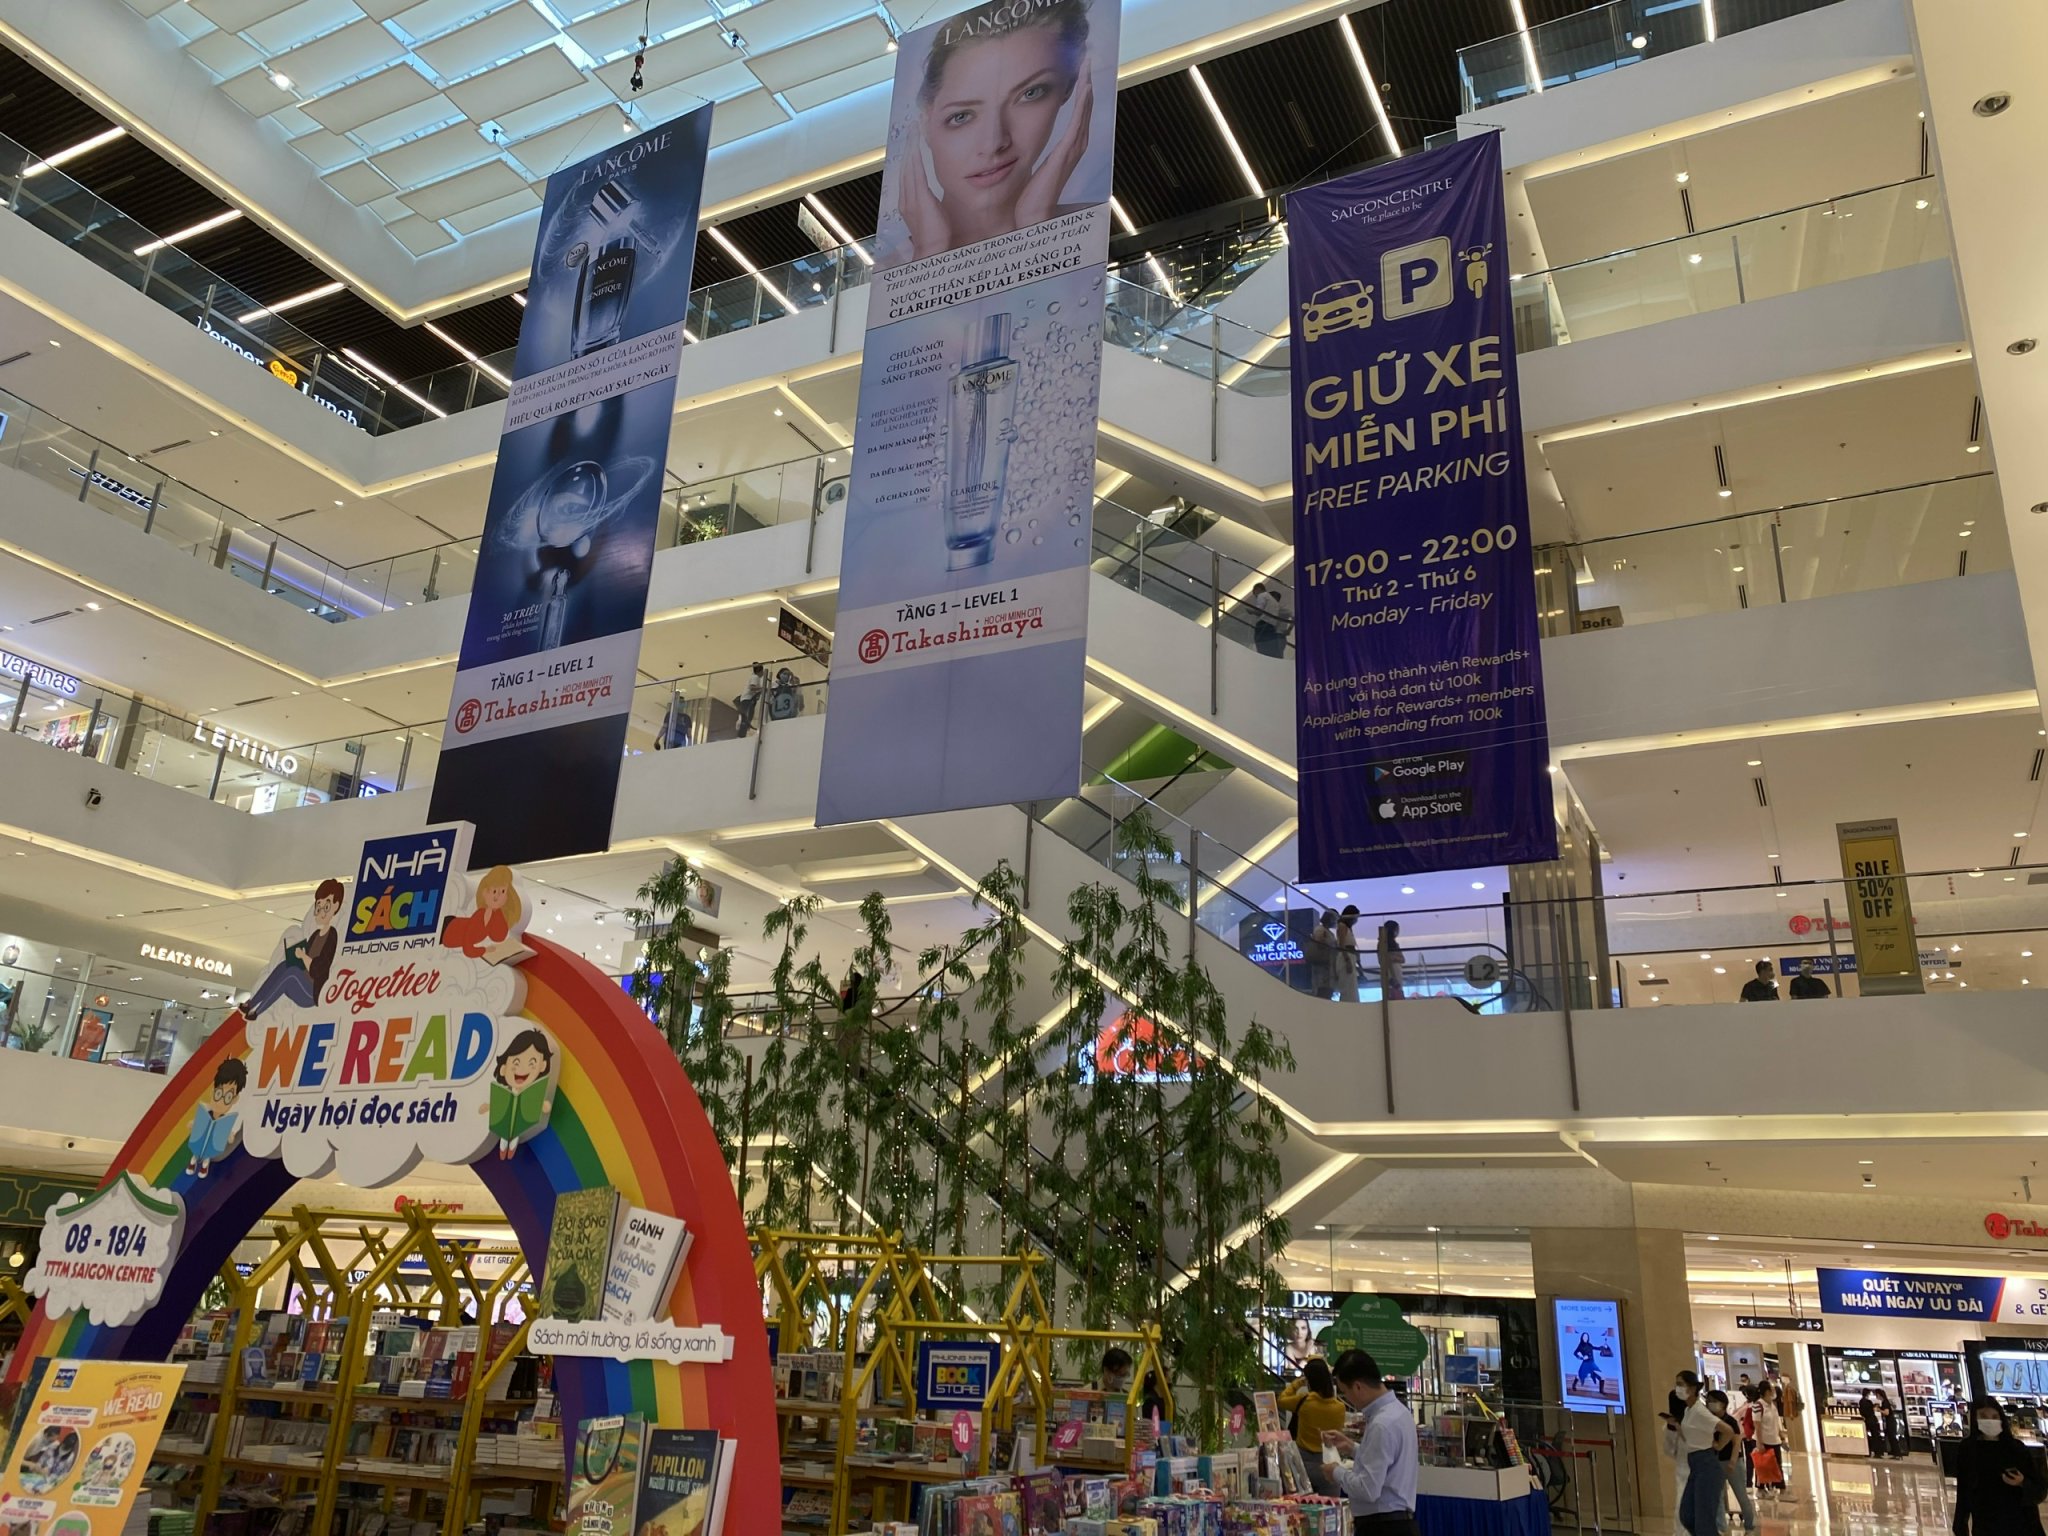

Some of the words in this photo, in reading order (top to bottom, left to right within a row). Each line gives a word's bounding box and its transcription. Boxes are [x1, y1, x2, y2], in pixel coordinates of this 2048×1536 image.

[581, 131, 673, 185] LANCÔME
[609, 163, 638, 180] PARIS
[1362, 214, 1378, 226] The
[1378, 207, 1400, 222] place
[1402, 205, 1410, 214] to
[1412, 201, 1422, 211] be
[886, 279, 906, 293] THU
[1029, 234, 1050, 250] SAU
[1023, 248, 1059, 269] SÁNG
[1062, 242, 1082, 257] DA
[888, 287, 973, 320] CLARIFIQUE
[975, 275, 1015, 295] DUAL
[1017, 255, 1082, 282] ESSENCE
[1399, 257, 1439, 306] P
[513, 380, 538, 396] CHAI
[537, 371, 567, 388] SERUM
[628, 330, 677, 356] LANCÔME
[886, 361, 908, 373] CHO
[930, 352, 943, 362] DA
[908, 363, 943, 379] TRONG
[588, 382, 617, 400] NGAY
[615, 376, 637, 391] SAU
[1304, 350, 1411, 420] GIỮ
[1422, 335, 1503, 395] XE
[1305, 412, 1416, 476] MIỄN
[1431, 387, 1507, 446] PHÍ
[1304, 479, 1372, 516] FREE
[1377, 451, 1511, 500] PARKING
[1304, 549, 1389, 587] 17:00
[1422, 524, 1518, 565] 22:00
[1343, 583, 1383, 603] Thứ
[1387, 580, 1399, 597] 2
[1418, 569, 1460, 590] Thứ
[1464, 564, 1477, 581] 6
[940, 601, 948, 614] 1
[964, 591, 1006, 610] LEVEL
[1010, 588, 1018, 601] 1
[1331, 606, 1410, 632] Monday
[1429, 592, 1494, 615] Friday
[984, 616, 994, 625] HO
[994, 613, 1007, 624] CHI
[1007, 610, 1027, 622] MINH
[1027, 606, 1044, 619] CITY
[892, 615, 1043, 653] Takashimaya
[527, 670, 534, 682] 1
[548, 659, 583, 679] LEVEL
[586, 656, 595, 669] 1
[1325, 676, 1357, 693] dụng
[1360, 671, 1386, 686] cho
[1388, 665, 1427, 682] thành
[1430, 661, 1459, 674] viên
[1462, 649, 1531, 669] Rewards+
[571, 682, 583, 692] CHI
[582, 679, 599, 691] MINH
[598, 675, 613, 687] CITY
[1349, 690, 1369, 703] với
[1399, 682, 1426, 697] đơn
[1447, 673, 1482, 689] 100k
[484, 684, 611, 723] Takashimaya
[775, 698, 790, 713] L3
[1302, 708, 1372, 730] Applicable
[1373, 704, 1392, 718] for
[1395, 695, 1463, 715] Rewards+
[1466, 684, 1535, 704] members
[1334, 727, 1361, 742] with
[1364, 718, 1428, 739] spending
[1430, 713, 1463, 728] from
[1468, 706, 1504, 722] 100k
[193, 720, 298, 774] LEMINO
[1392, 763, 1436, 778] Google
[1438, 759, 1465, 774] Play
[1402, 803, 1429, 818] App
[1430, 801, 1463, 815] Store
[362, 838, 447, 883] NHÀ
[1855, 860, 1889, 878] SALE
[1857, 878, 1894, 898] 50%
[351, 885, 439, 935] SÁCH
[1863, 898, 1893, 919] OFF
[140, 943, 192, 968] PLEATS
[194, 956, 233, 976] KORA
[341, 941, 400, 956] PHƯƠNG
[403, 937, 435, 950] NAM
[1468, 965, 1496, 981] L2
[325, 962, 442, 1014] Together
[257, 1022, 336, 1089] WE
[339, 1012, 494, 1085] READ
[261, 1099, 317, 1134] Ngày
[318, 1094, 358, 1130] hội
[360, 1094, 404, 1129] đọc
[406, 1091, 458, 1124] sách
[65, 1223, 92, 1254] 08
[106, 1224, 147, 1257] 18/4
[629, 1218, 664, 1241] GIÀNH
[44, 1261, 71, 1278] TTTM
[70, 1262, 115, 1281] SAIGON
[116, 1266, 158, 1284] CENTRE
[484, 1256, 496, 1264] GET
[617, 1249, 657, 1277] KHÔNG
[1863, 1278, 1900, 1293] QUÉT
[1293, 1291, 1333, 1309] Dior
[1841, 1293, 1882, 1310] NHẬN
[1887, 1296, 1924, 1310] NGAY
[1957, 1297, 1983, 1313] ĐÃI
[533, 1329, 564, 1345] Sách
[565, 1330, 589, 1345] môi
[590, 1331, 632, 1352] trường,
[635, 1330, 650, 1349] lối
[651, 1331, 682, 1354] sống
[683, 1335, 717, 1352] xanh
[1900, 1351, 1929, 1359] CAROLINA
[1930, 1352, 1958, 1360] HERRERA
[936, 1366, 981, 1384] BOOK
[935, 1384, 981, 1395] STORE
[103, 1397, 125, 1417] WE
[126, 1391, 163, 1413] READ
[955, 1422, 969, 1442] -10
[1057, 1428, 1076, 1442] -10
[650, 1454, 706, 1479] PAPILLON
